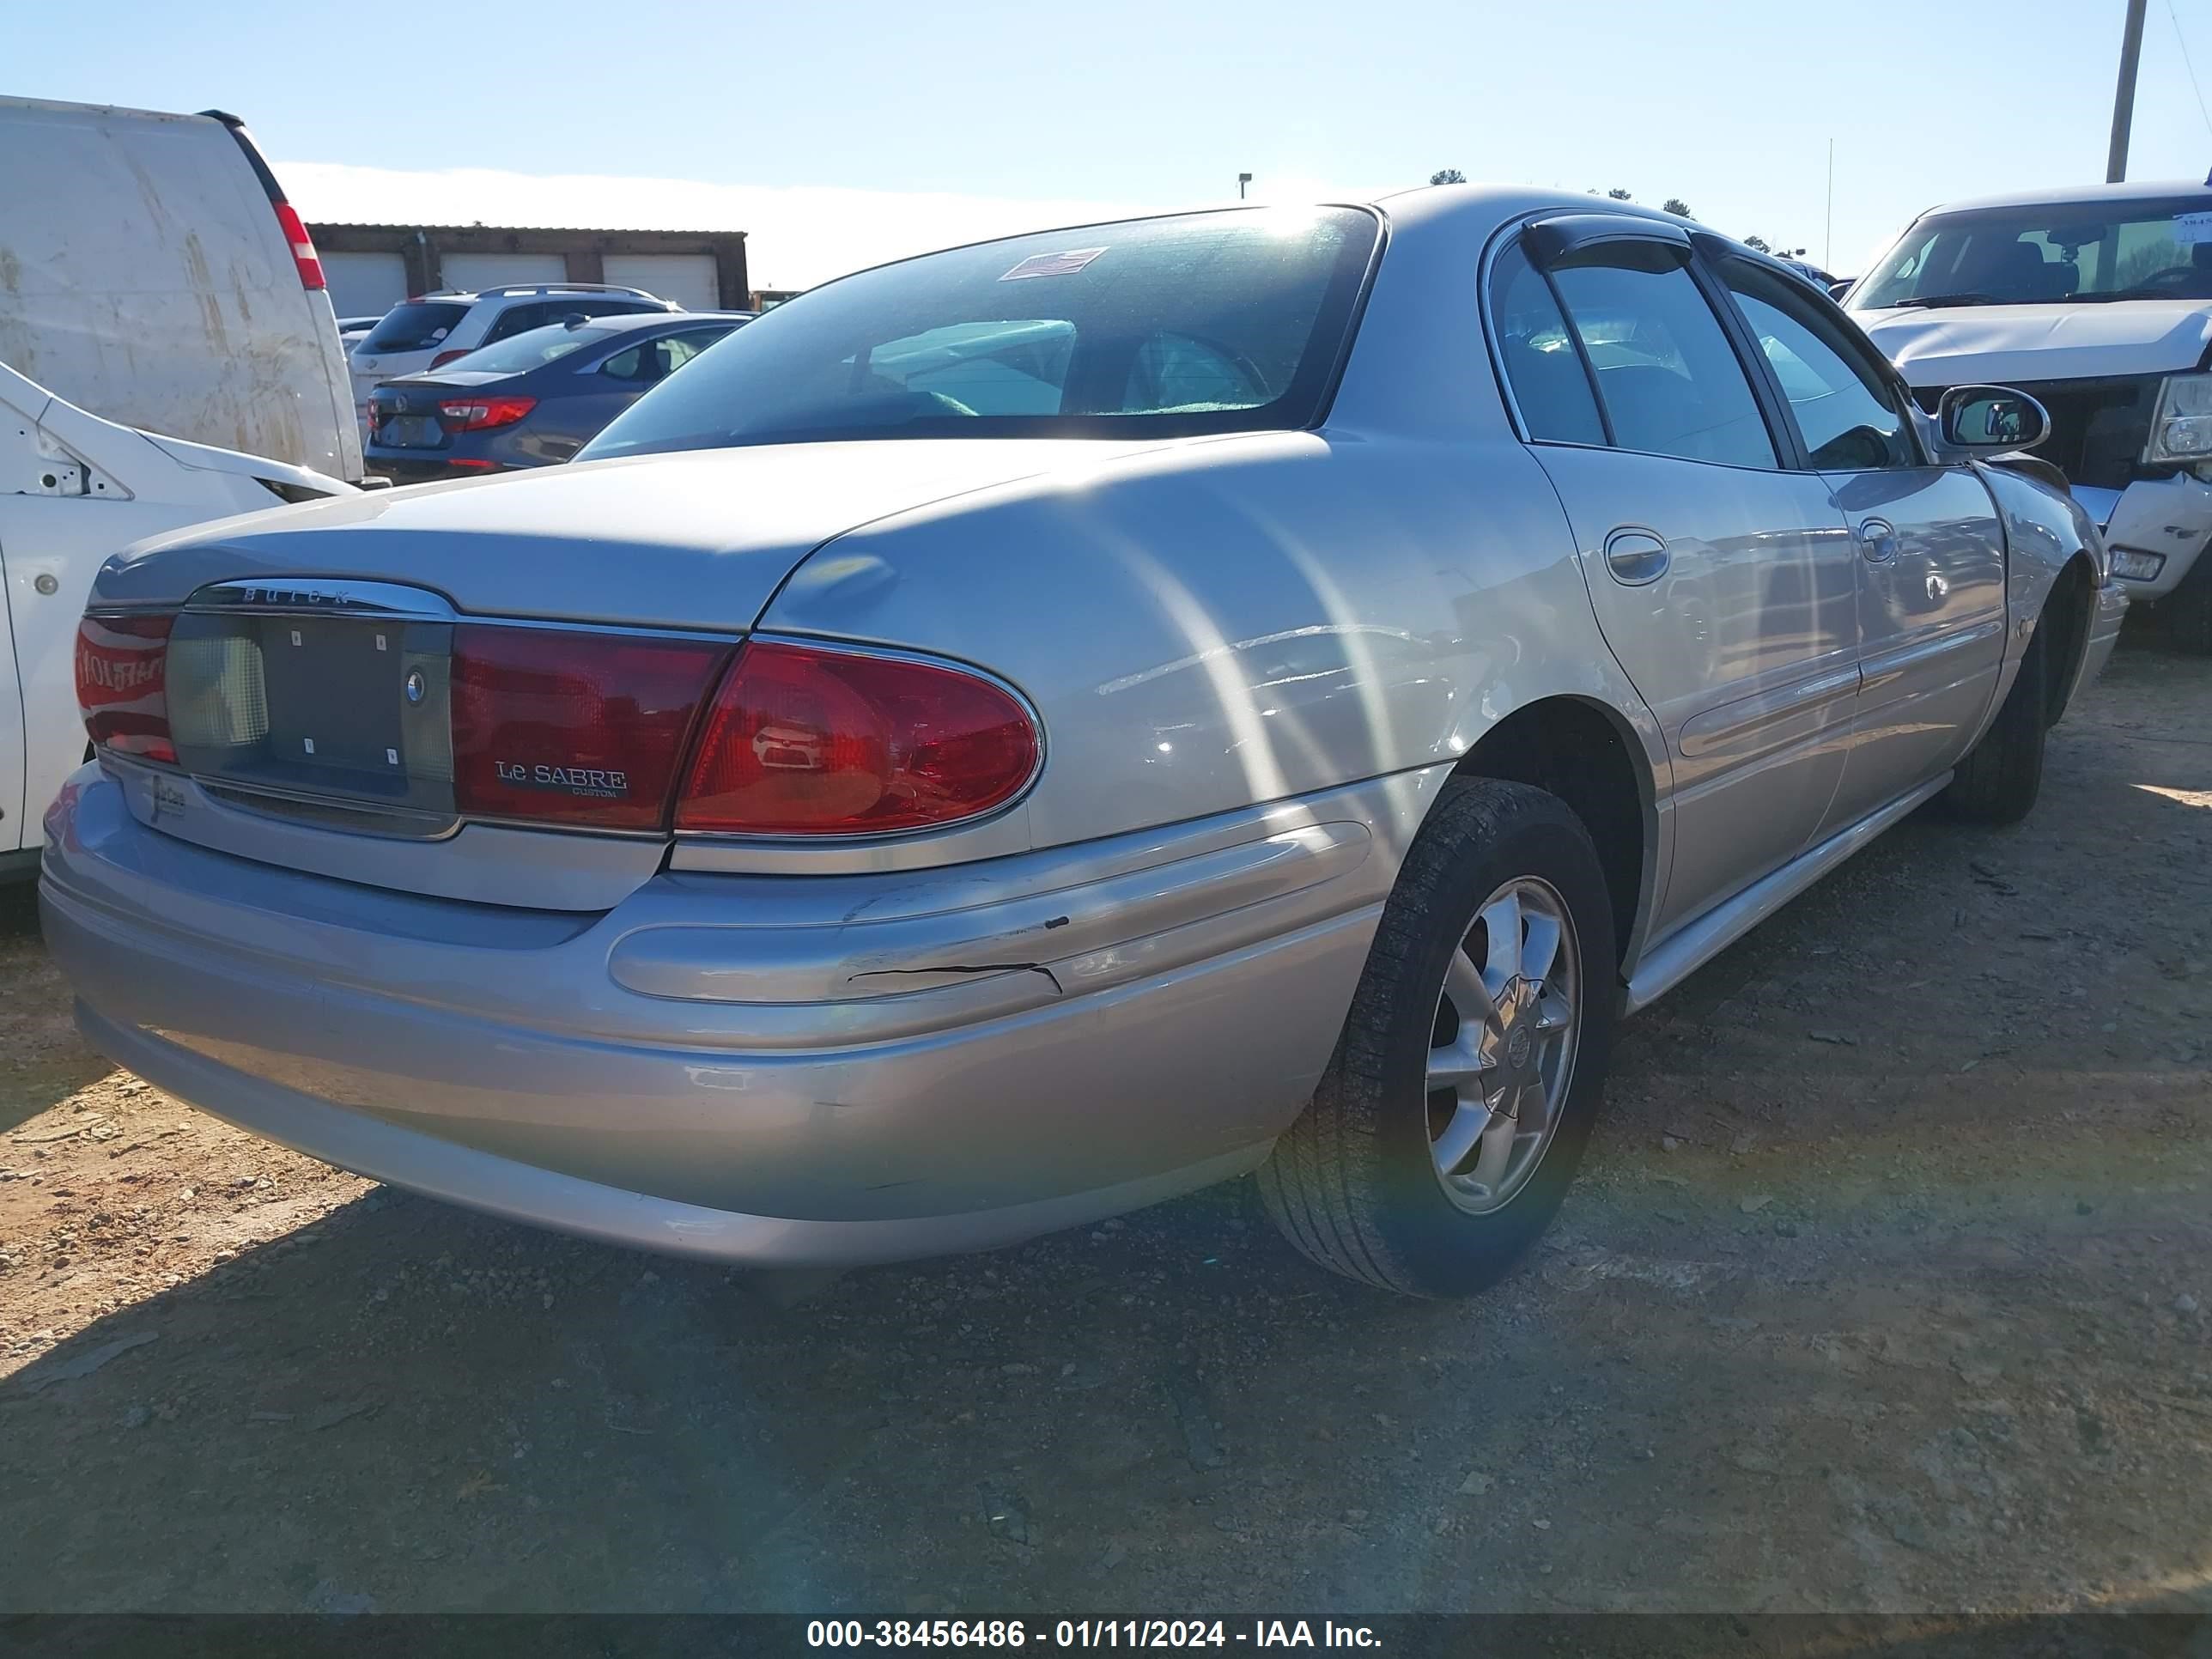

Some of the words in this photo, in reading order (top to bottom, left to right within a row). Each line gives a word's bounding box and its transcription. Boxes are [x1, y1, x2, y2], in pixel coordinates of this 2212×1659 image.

[244, 587, 349, 605] BUICK
[495, 761, 527, 781] Le
[535, 765, 627, 790] SABRE
[572, 787, 617, 799] CUSTOM
